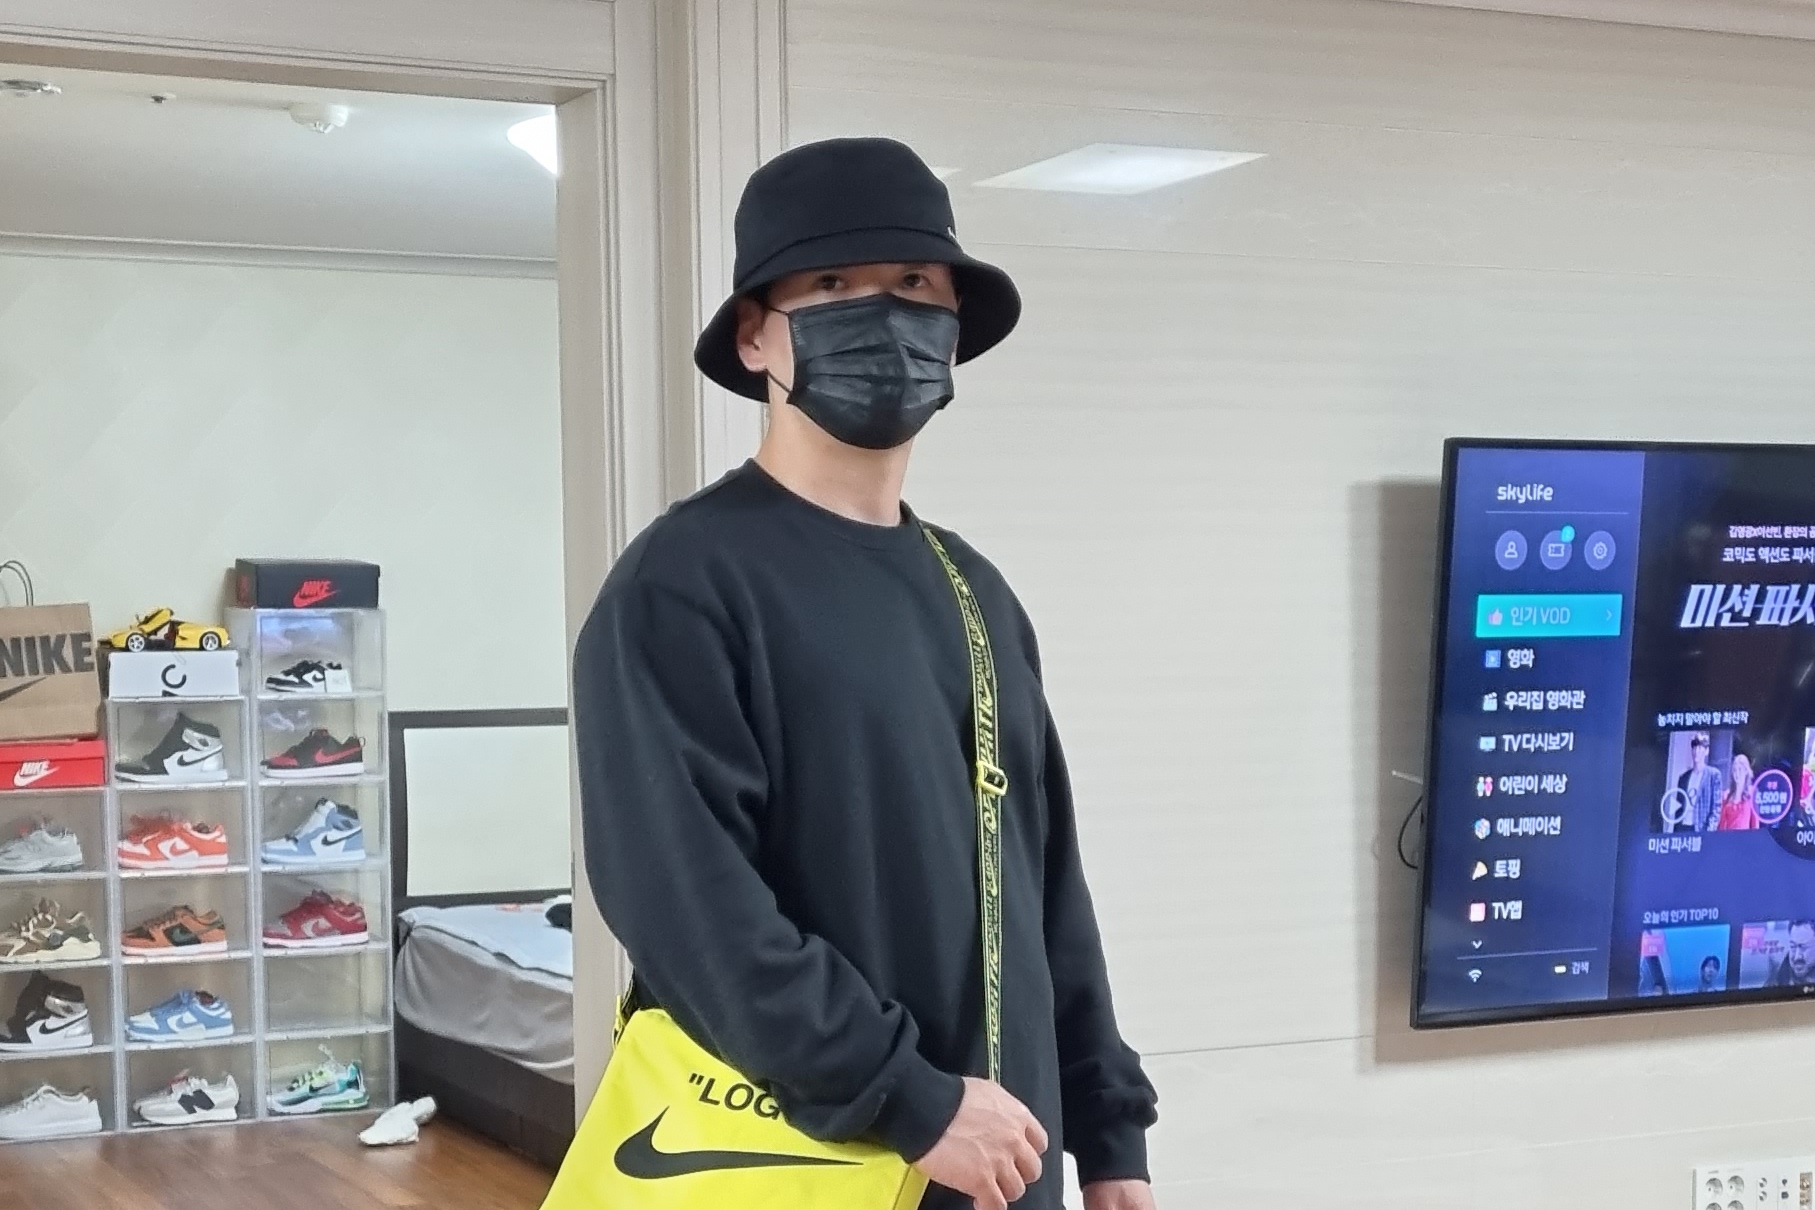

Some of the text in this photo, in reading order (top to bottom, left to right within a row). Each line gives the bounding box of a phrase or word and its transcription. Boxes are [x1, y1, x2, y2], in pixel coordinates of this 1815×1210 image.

[1497, 483, 1553, 504] skylife
[1723, 547, 1756, 564] 코믹도
[1758, 546, 1791, 564] 액션도
[301, 580, 333, 597] NIKE
[1510, 607, 1571, 626] 인기 VOD
[1680, 584, 1761, 628] 미션
[0, 632, 95, 678] NIKE
[1507, 648, 1535, 669] 영화
[1504, 690, 1586, 711] 우리집 영화관
[20, 760, 49, 776] NIKE
[1500, 773, 1567, 795] 어린이 세상
[1496, 815, 1562, 837] 애니메이션
[1648, 836, 1702, 854] 미션 파서블
[1493, 858, 1521, 879] 토핑
[1642, 907, 1720, 925] 오늘의 인기 TOP10
